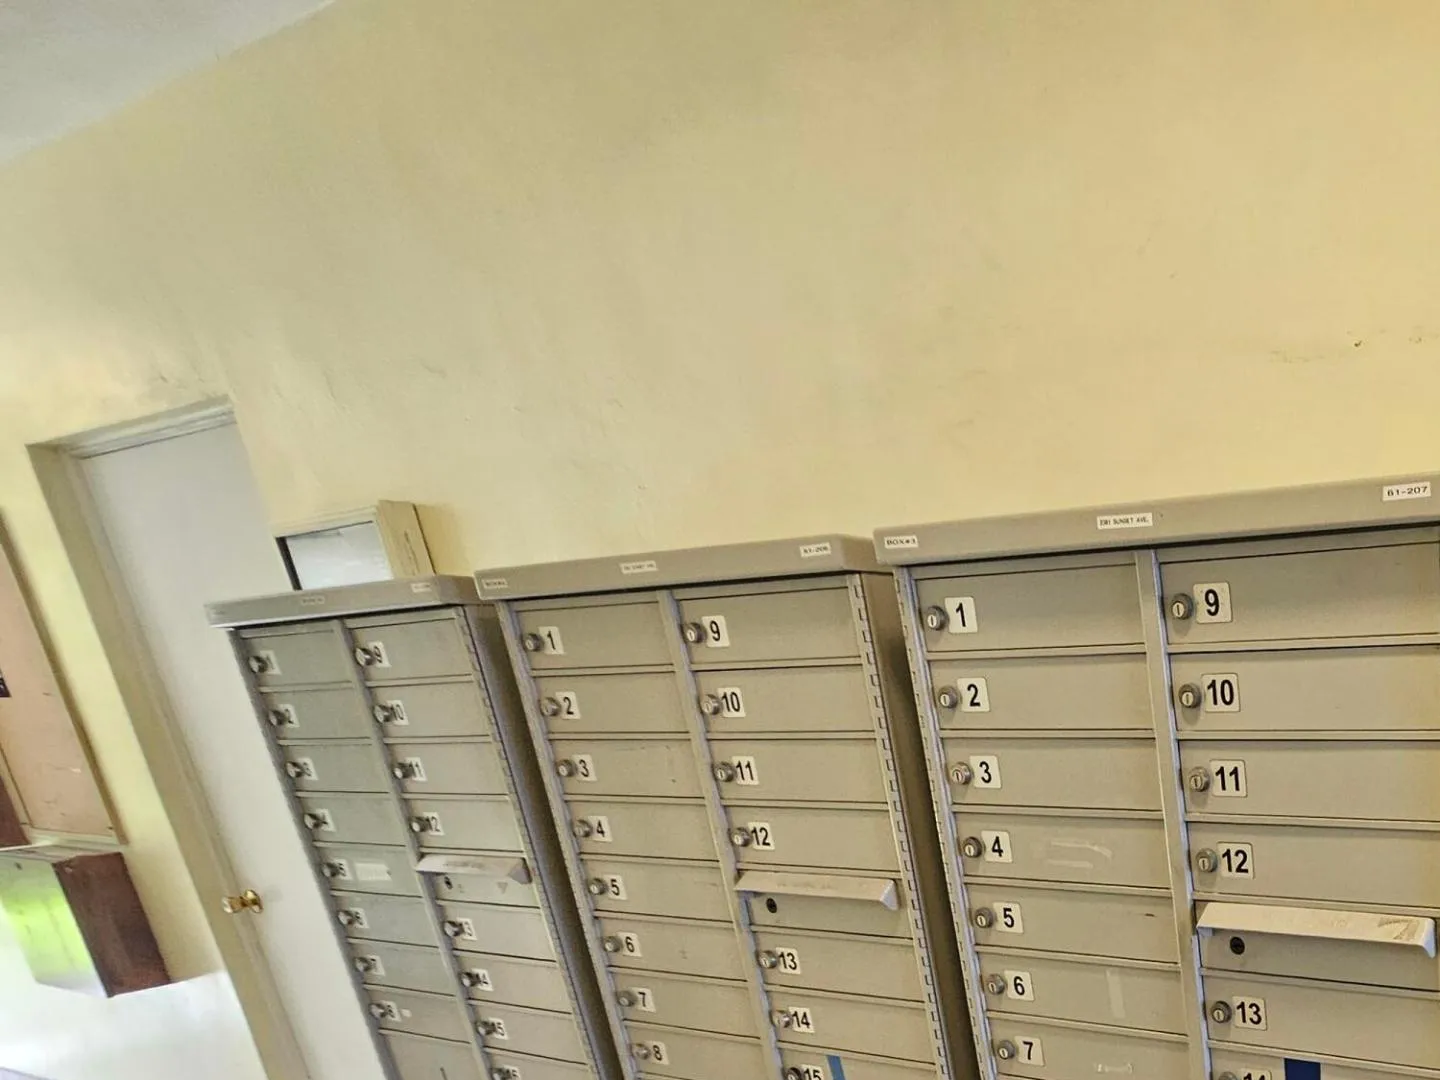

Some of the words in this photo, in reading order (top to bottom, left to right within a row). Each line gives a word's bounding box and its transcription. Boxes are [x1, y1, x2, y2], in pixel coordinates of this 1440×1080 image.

[1205, 589, 1219, 616] 9
[956, 603, 965, 627] 1
[547, 631, 555, 649] 1
[710, 621, 720, 641] 9
[373, 645, 383, 664] 9
[721, 692, 740, 712] 10
[967, 684, 980, 706] 2
[1207, 680, 1234, 705] 10
[564, 697, 574, 715] 2
[579, 760, 589, 777] 3
[736, 761, 753, 780] 11
[980, 761, 991, 783] 3
[1216, 767, 1239, 791] 11
[597, 821, 604, 837] 4
[752, 827, 770, 846] 12
[992, 836, 1003, 857] 4
[1222, 849, 1248, 873] 12
[611, 879, 619, 895] 5
[1003, 908, 1014, 928] 5
[625, 937, 634, 952] 6
[779, 952, 797, 970] 13
[1014, 976, 1025, 995] 6
[638, 992, 646, 1007] 7
[792, 1010, 810, 1028] 14
[1237, 1002, 1261, 1025] 13
[653, 1045, 662, 1061] 8
[1023, 1041, 1033, 1060] 7
